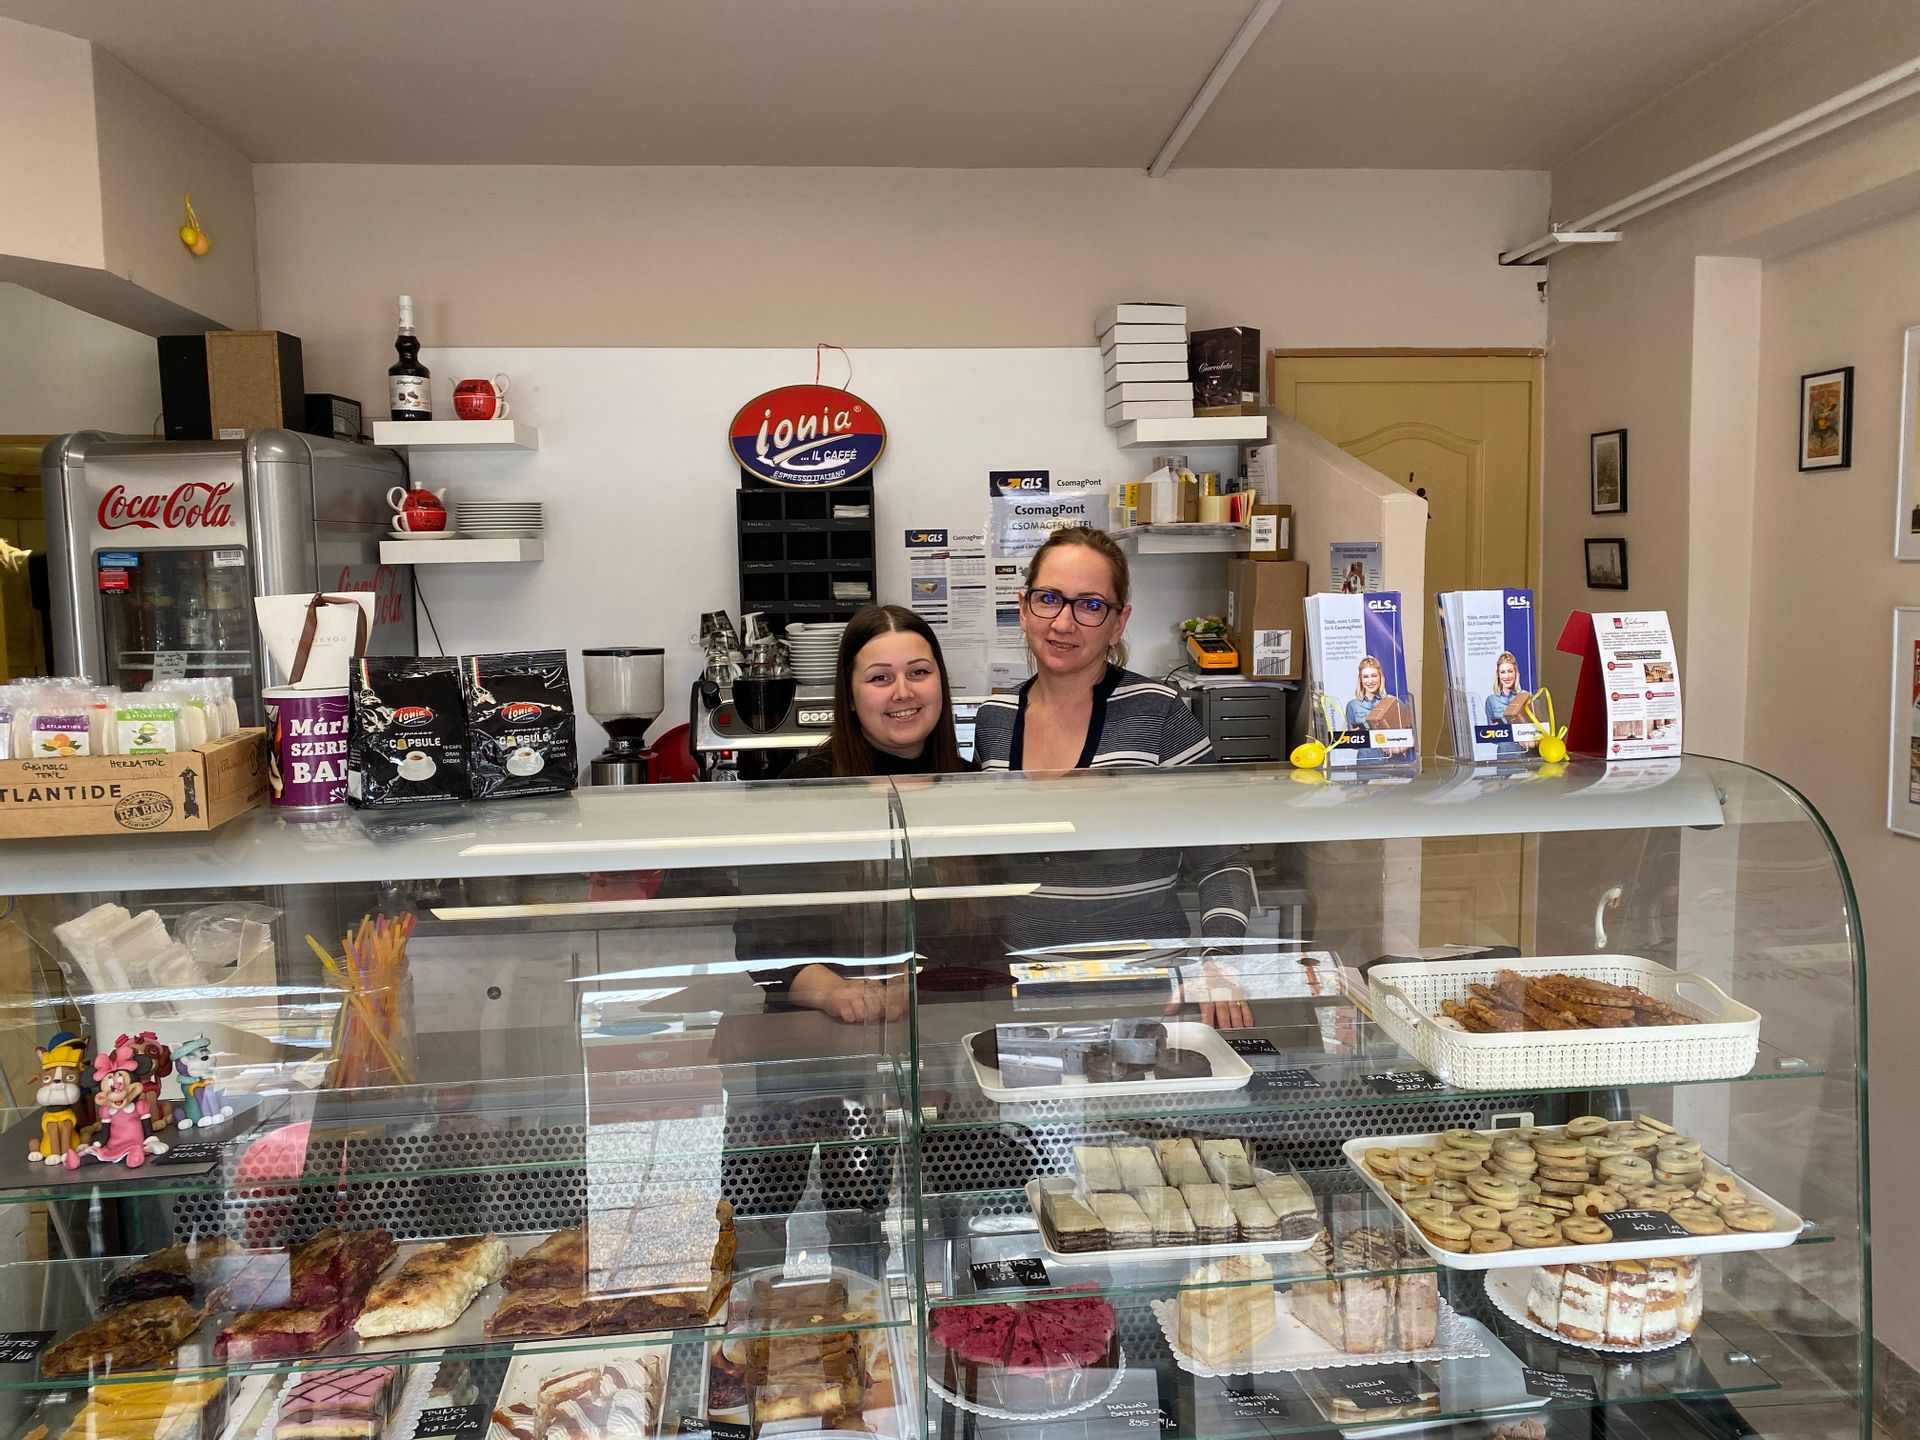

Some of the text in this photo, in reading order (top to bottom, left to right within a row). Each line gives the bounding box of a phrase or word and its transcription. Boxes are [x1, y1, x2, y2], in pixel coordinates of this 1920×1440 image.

[756, 406, 852, 457] ionia
[812, 451, 821, 460] IL
[824, 449, 857, 460] CAFFÈ
[773, 469, 846, 482] ESPRESSO ITALIANO
[1021, 478, 1102, 489] GLS CsomagPont
[98, 482, 235, 530] Coca-Cola
[1015, 504, 1085, 516] CsomagPont
[928, 534, 943, 542] GLS
[1495, 729, 1509, 737] GLS
[1350, 735, 1365, 744] GLS
[0, 784, 121, 803] TLANTIDE
[117, 801, 171, 821] TEA BAGS
[1345, 1380, 1386, 1389] NUTELLA
